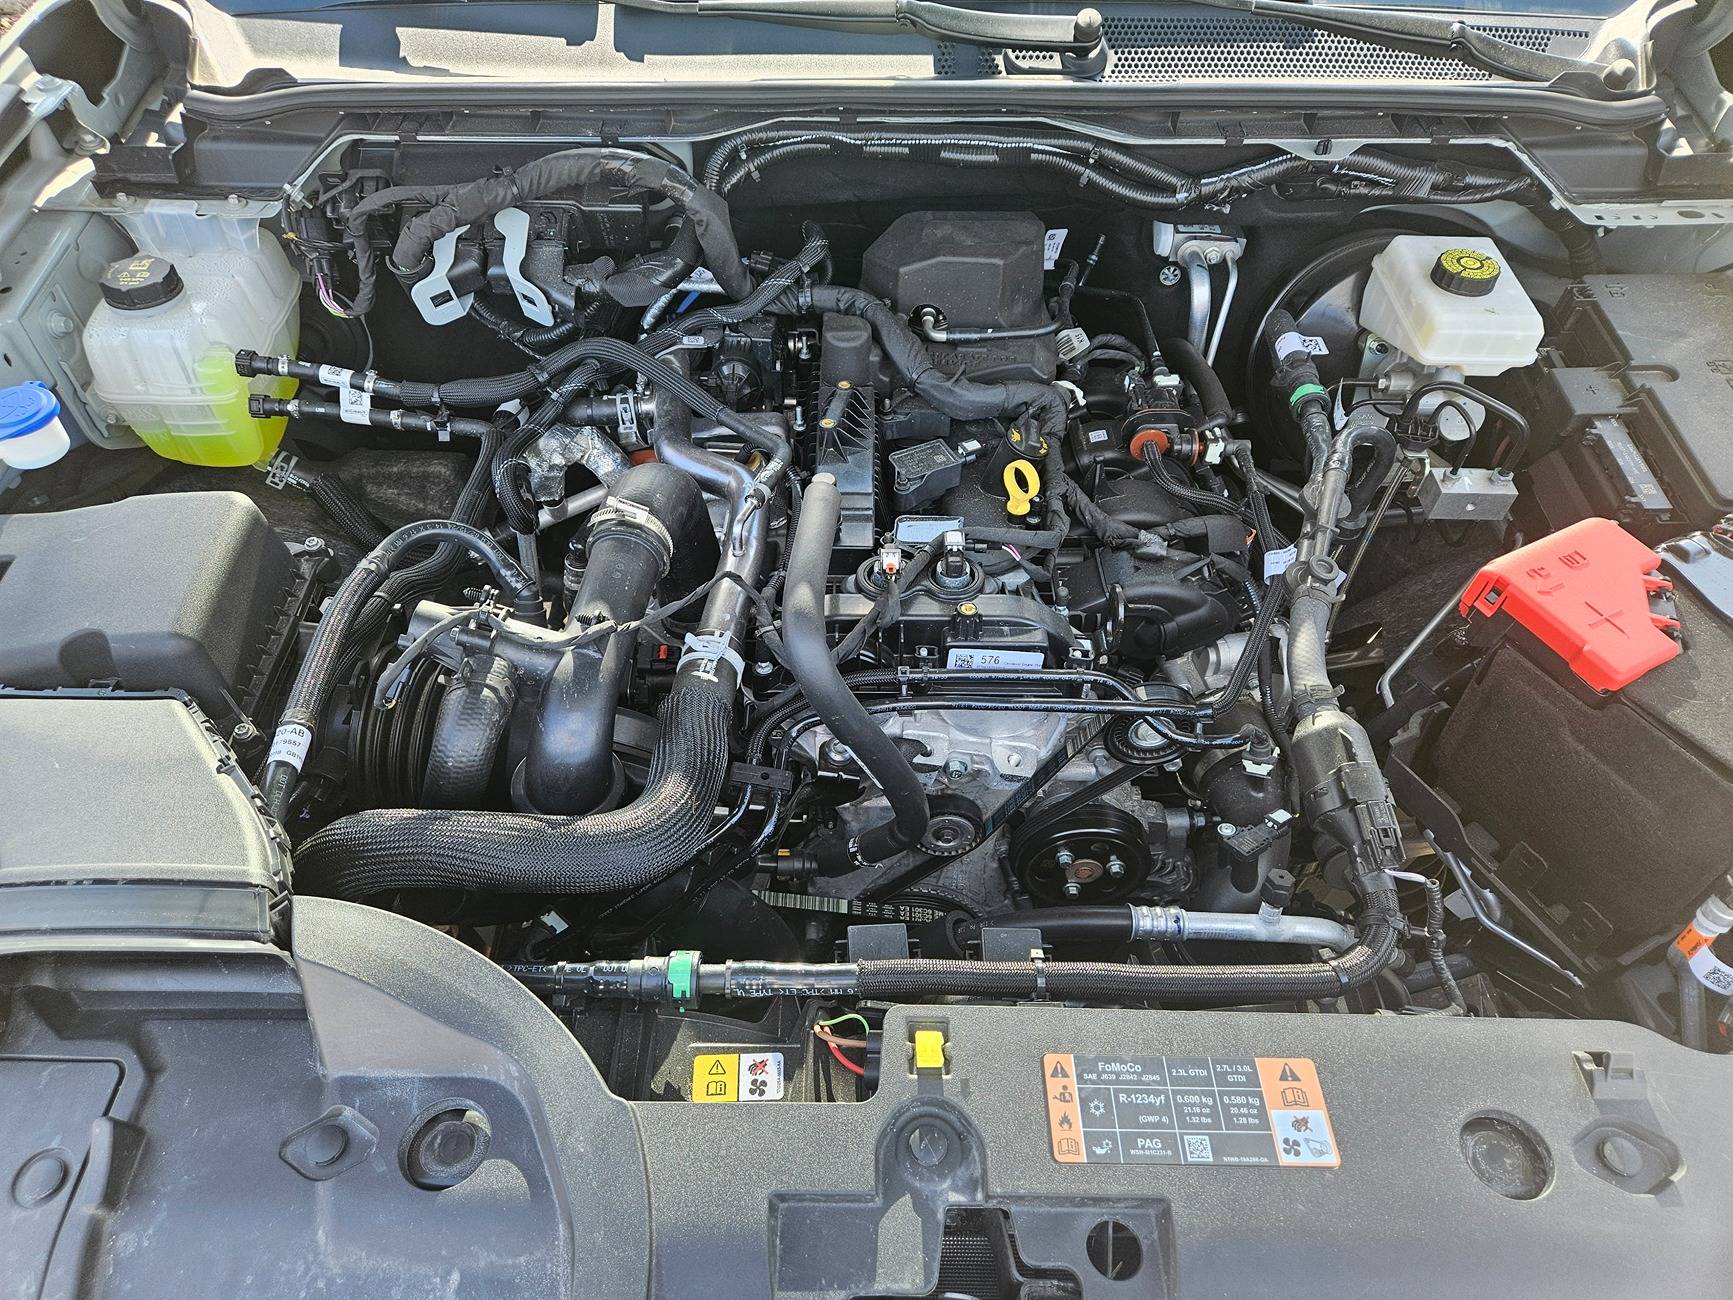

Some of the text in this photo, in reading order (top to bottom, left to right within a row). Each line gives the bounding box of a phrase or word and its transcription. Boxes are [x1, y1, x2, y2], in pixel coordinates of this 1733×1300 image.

[981, 655, 1000, 665] 576
[750, 988, 773, 997] TYPE
[1098, 1062, 1142, 1072] FoMoCo
[1119, 1093, 1166, 1105] R-1234yf
[1177, 1095, 1213, 1105] 0.600 kg
[1223, 1096, 1260, 1106] 0.580 kg
[1138, 1115, 1169, 1124] (GWP 4)
[1137, 1138, 1162, 1148] PAG
